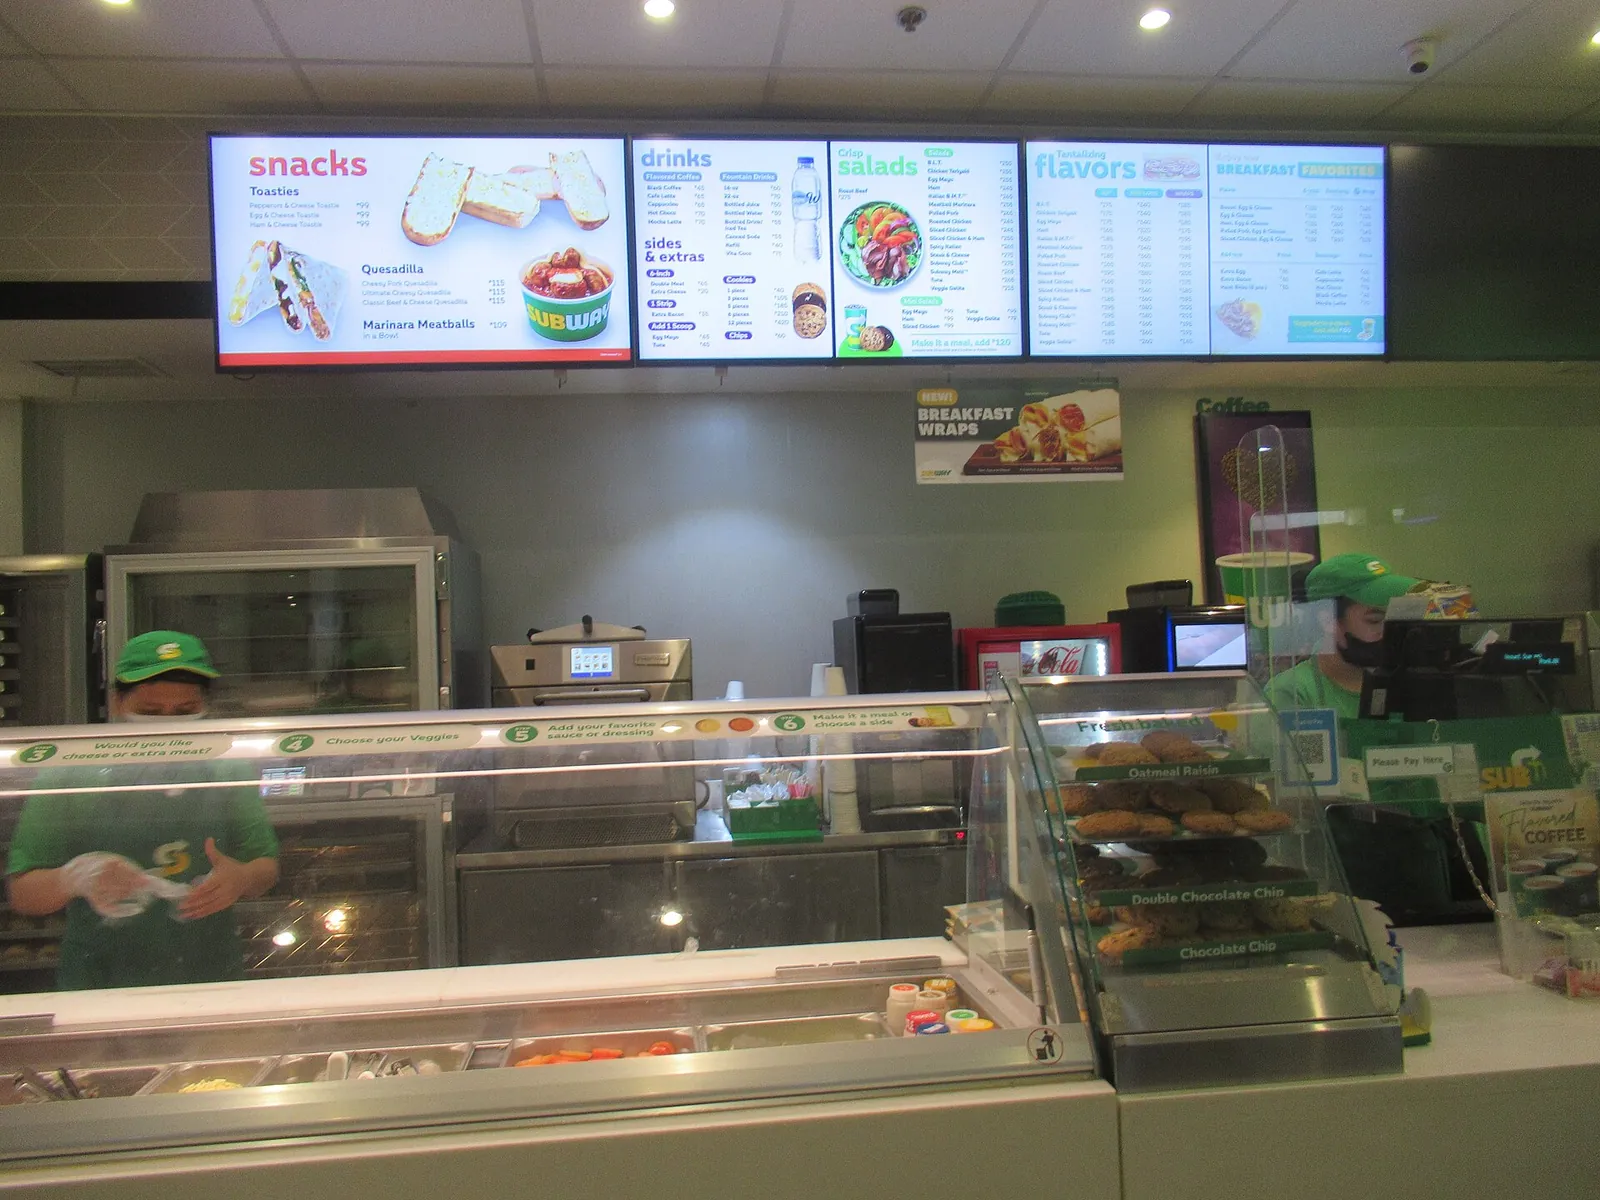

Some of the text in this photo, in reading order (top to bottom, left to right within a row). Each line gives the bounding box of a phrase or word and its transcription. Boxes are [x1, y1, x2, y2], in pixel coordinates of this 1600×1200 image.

[641, 148, 712, 167] drinks
[838, 148, 864, 158] Crisp
[249, 149, 368, 177] snacks
[838, 154, 918, 176] salads
[1034, 153, 1137, 179] flavors
[1216, 164, 1296, 176] BREAKFAST
[249, 186, 300, 196] Toasties
[644, 237, 682, 249] sides
[645, 250, 704, 262] & extras
[362, 264, 424, 276] Quesadilla
[527, 303, 610, 331] SUBWAY
[363, 320, 414, 329] Marinara
[418, 320, 476, 329] Meatballs
[922, 391, 953, 402] NEW!
[1196, 396, 1270, 414] Coffee
[918, 408, 1014, 421] BREAKFAST
[918, 423, 978, 436] WRAPS
[577, 723, 606, 732] your
[608, 721, 656, 729] favorite
[783, 720, 798, 730] 6
[814, 720, 856, 728] choose
[326, 733, 460, 745] Choose your Veggies
[514, 730, 530, 742] 5
[602, 728, 654, 738] dressing
[94, 738, 193, 750] Would you like
[286, 738, 304, 750] 4
[26, 750, 46, 762] 3
[62, 752, 110, 760] cheese
[170, 747, 212, 756] meat?
[1372, 756, 1443, 767] Please Pay Here
[1129, 764, 1220, 778] Oatmeal Raisin
[1524, 828, 1585, 844] COFFEE
[1132, 887, 1285, 906] Double Chocolate Chip
[1180, 940, 1277, 960] Chocolate Chip
